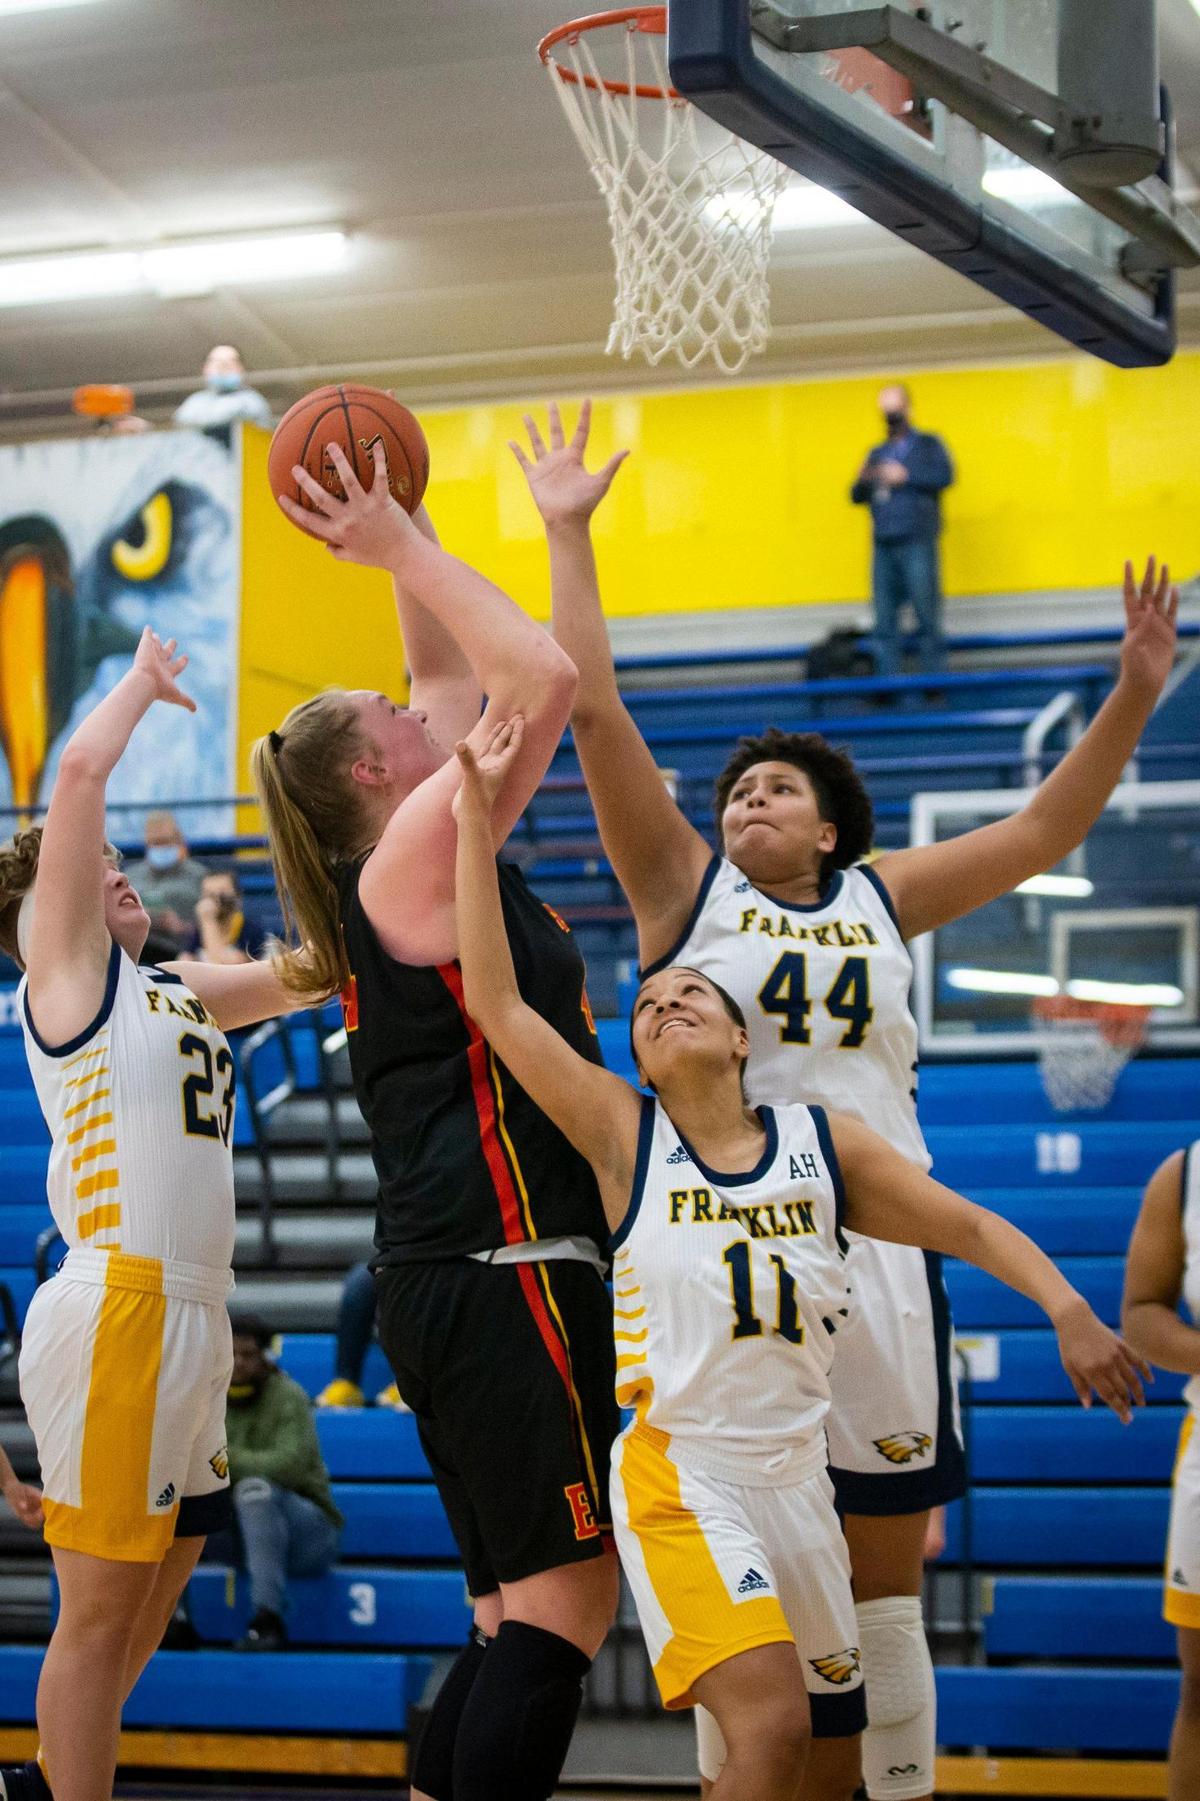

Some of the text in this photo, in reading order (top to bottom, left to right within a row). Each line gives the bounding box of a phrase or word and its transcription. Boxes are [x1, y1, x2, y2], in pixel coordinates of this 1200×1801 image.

[757, 951, 875, 1049] 44
[177, 1031, 236, 1148] 23
[789, 1153, 820, 1180] AH
[721, 1238, 805, 1345] 11
[564, 1481, 600, 1541] E
[349, 1582, 377, 1626] 3
